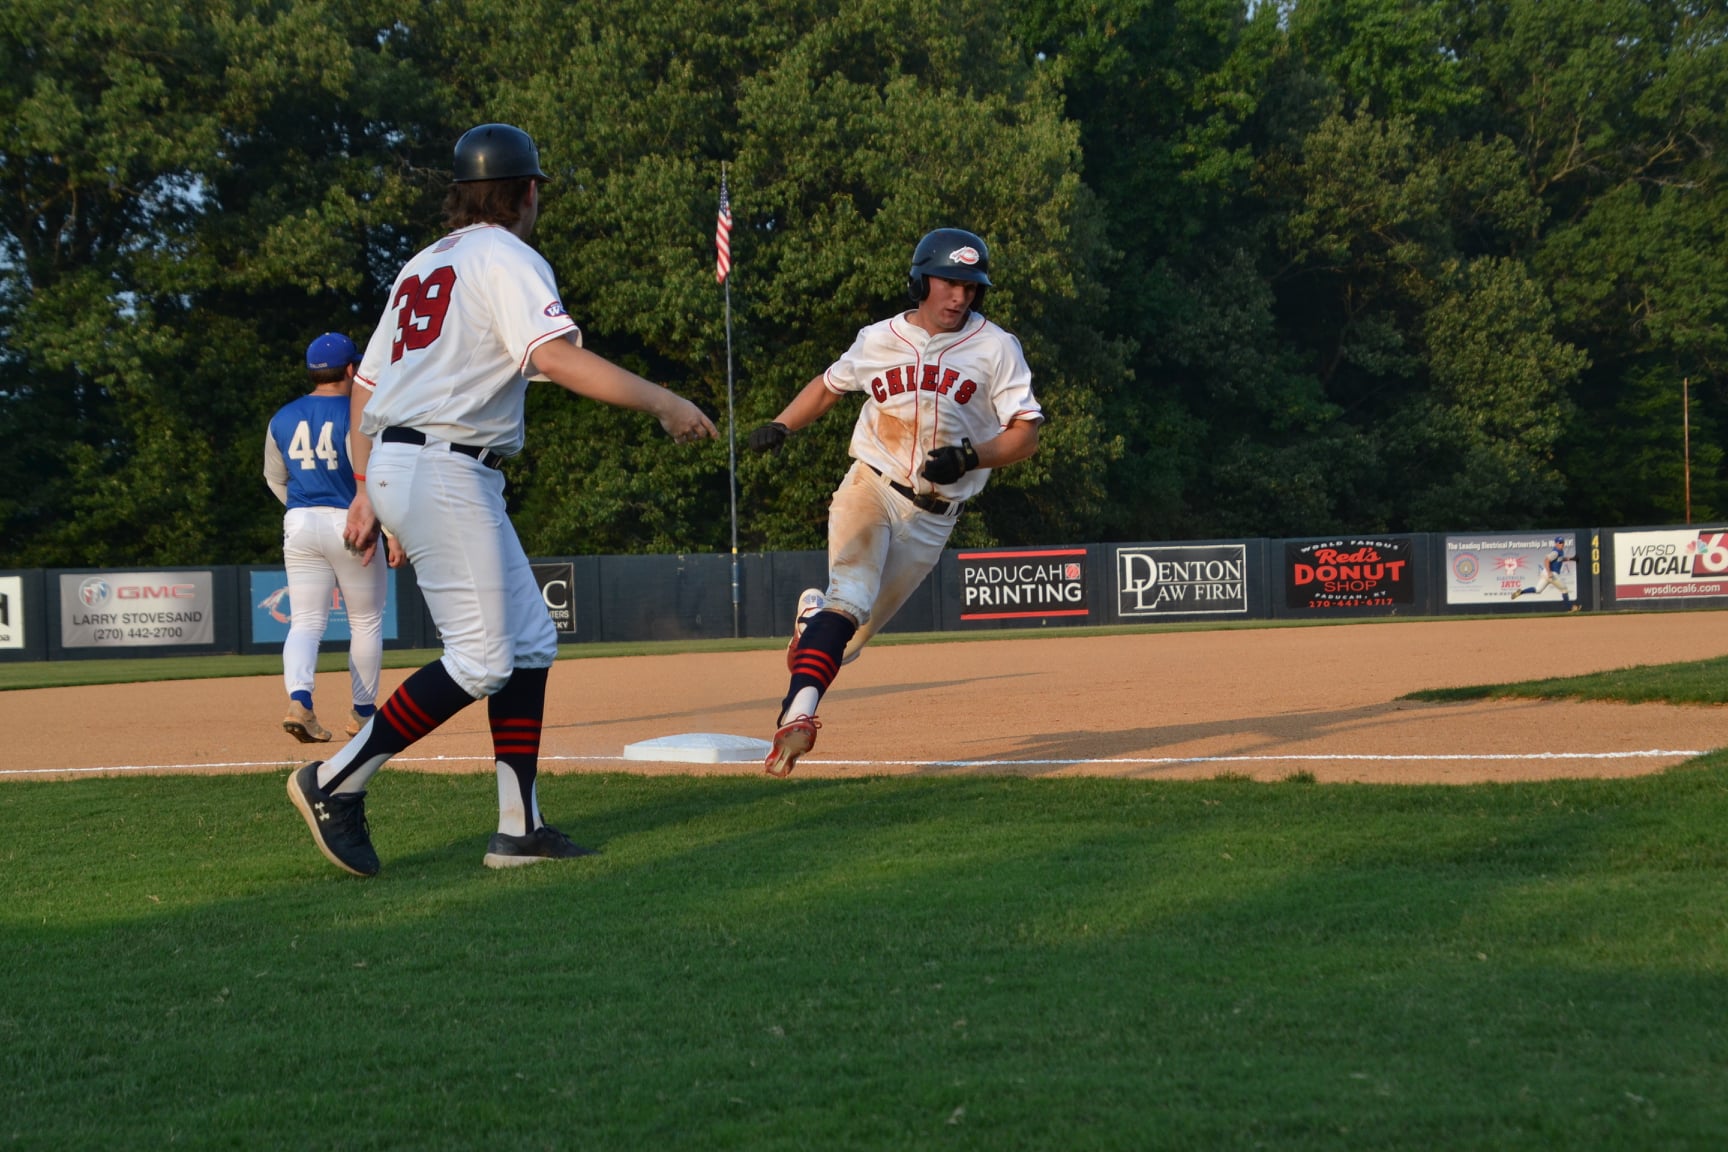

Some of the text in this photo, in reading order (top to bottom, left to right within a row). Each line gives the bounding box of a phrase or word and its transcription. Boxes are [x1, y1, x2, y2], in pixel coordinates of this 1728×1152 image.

[391, 265, 457, 365] 39
[871, 364, 977, 405] CHIEFS
[288, 420, 338, 470] 44
[1301, 540, 1399, 553] WORLD FAMOUS
[1459, 541, 1480, 550] Leading
[1482, 541, 1507, 549] Electrical
[1509, 541, 1540, 549] Partnership
[1591, 534, 1600, 575] 400
[1629, 533, 1728, 576] LOCAL 6
[1631, 544, 1676, 556] WPSD
[1314, 547, 1382, 565] Red's
[965, 564, 1063, 584] PADUCAH
[1120, 553, 1243, 593] DENTON
[1294, 560, 1406, 586] DONUT
[117, 584, 195, 600] GMC
[966, 583, 1082, 606] PRINTING
[1134, 580, 1242, 609] LAW FIRM
[1324, 580, 1377, 592] SHOP
[1643, 584, 1721, 596] wpsdlocal6.com
[1315, 592, 1368, 600] PADUCAH,
[73, 611, 203, 626] LARRY STOVESAND
[93, 627, 183, 642] (270) 442-2700
